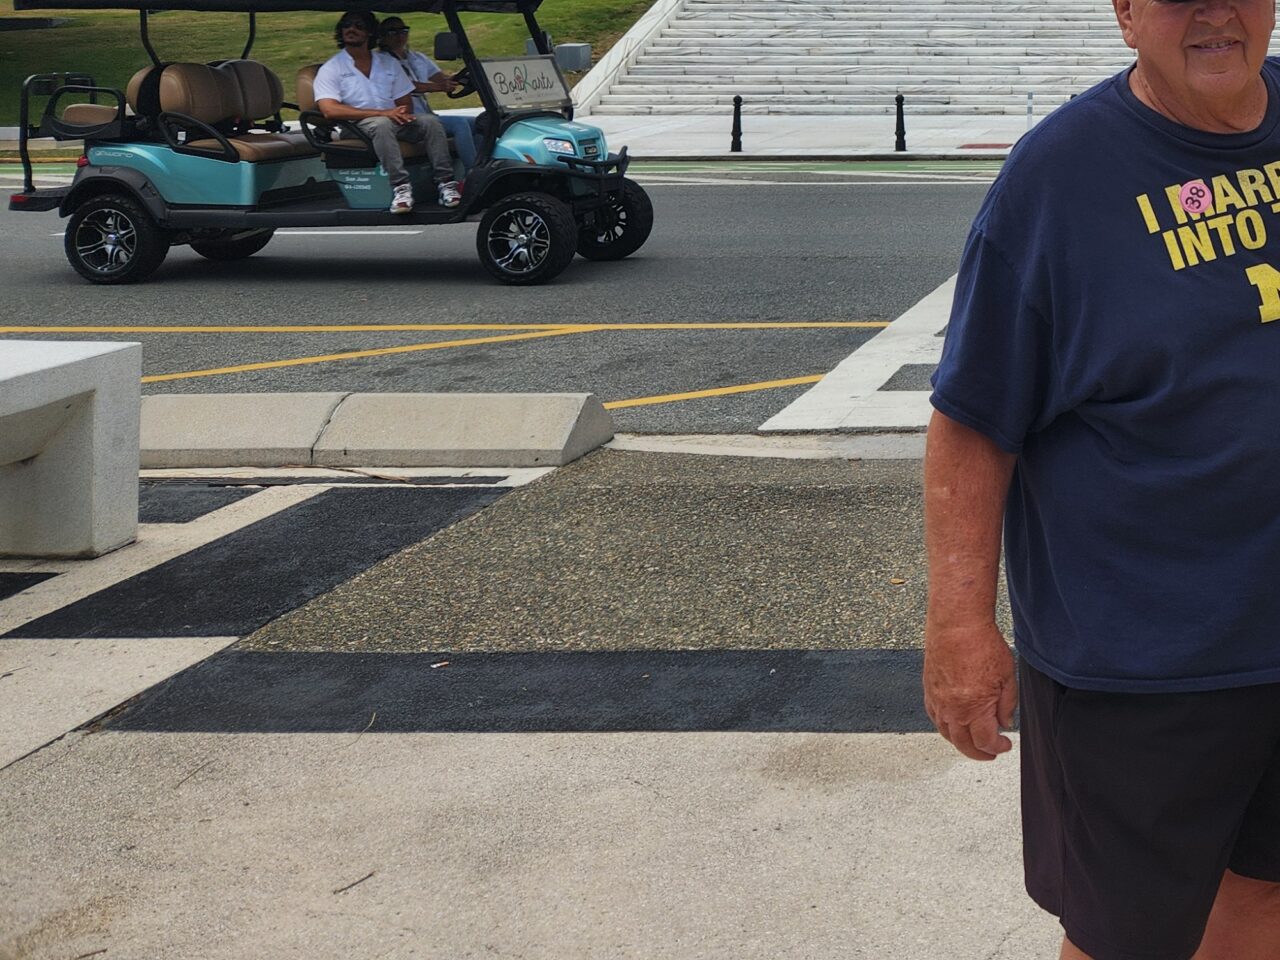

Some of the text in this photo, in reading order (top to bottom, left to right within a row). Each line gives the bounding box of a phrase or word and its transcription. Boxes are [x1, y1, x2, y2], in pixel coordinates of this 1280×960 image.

[1136, 193, 1161, 234] I
[1185, 185, 1206, 210] 38
[1162, 209, 1267, 271] INTO
